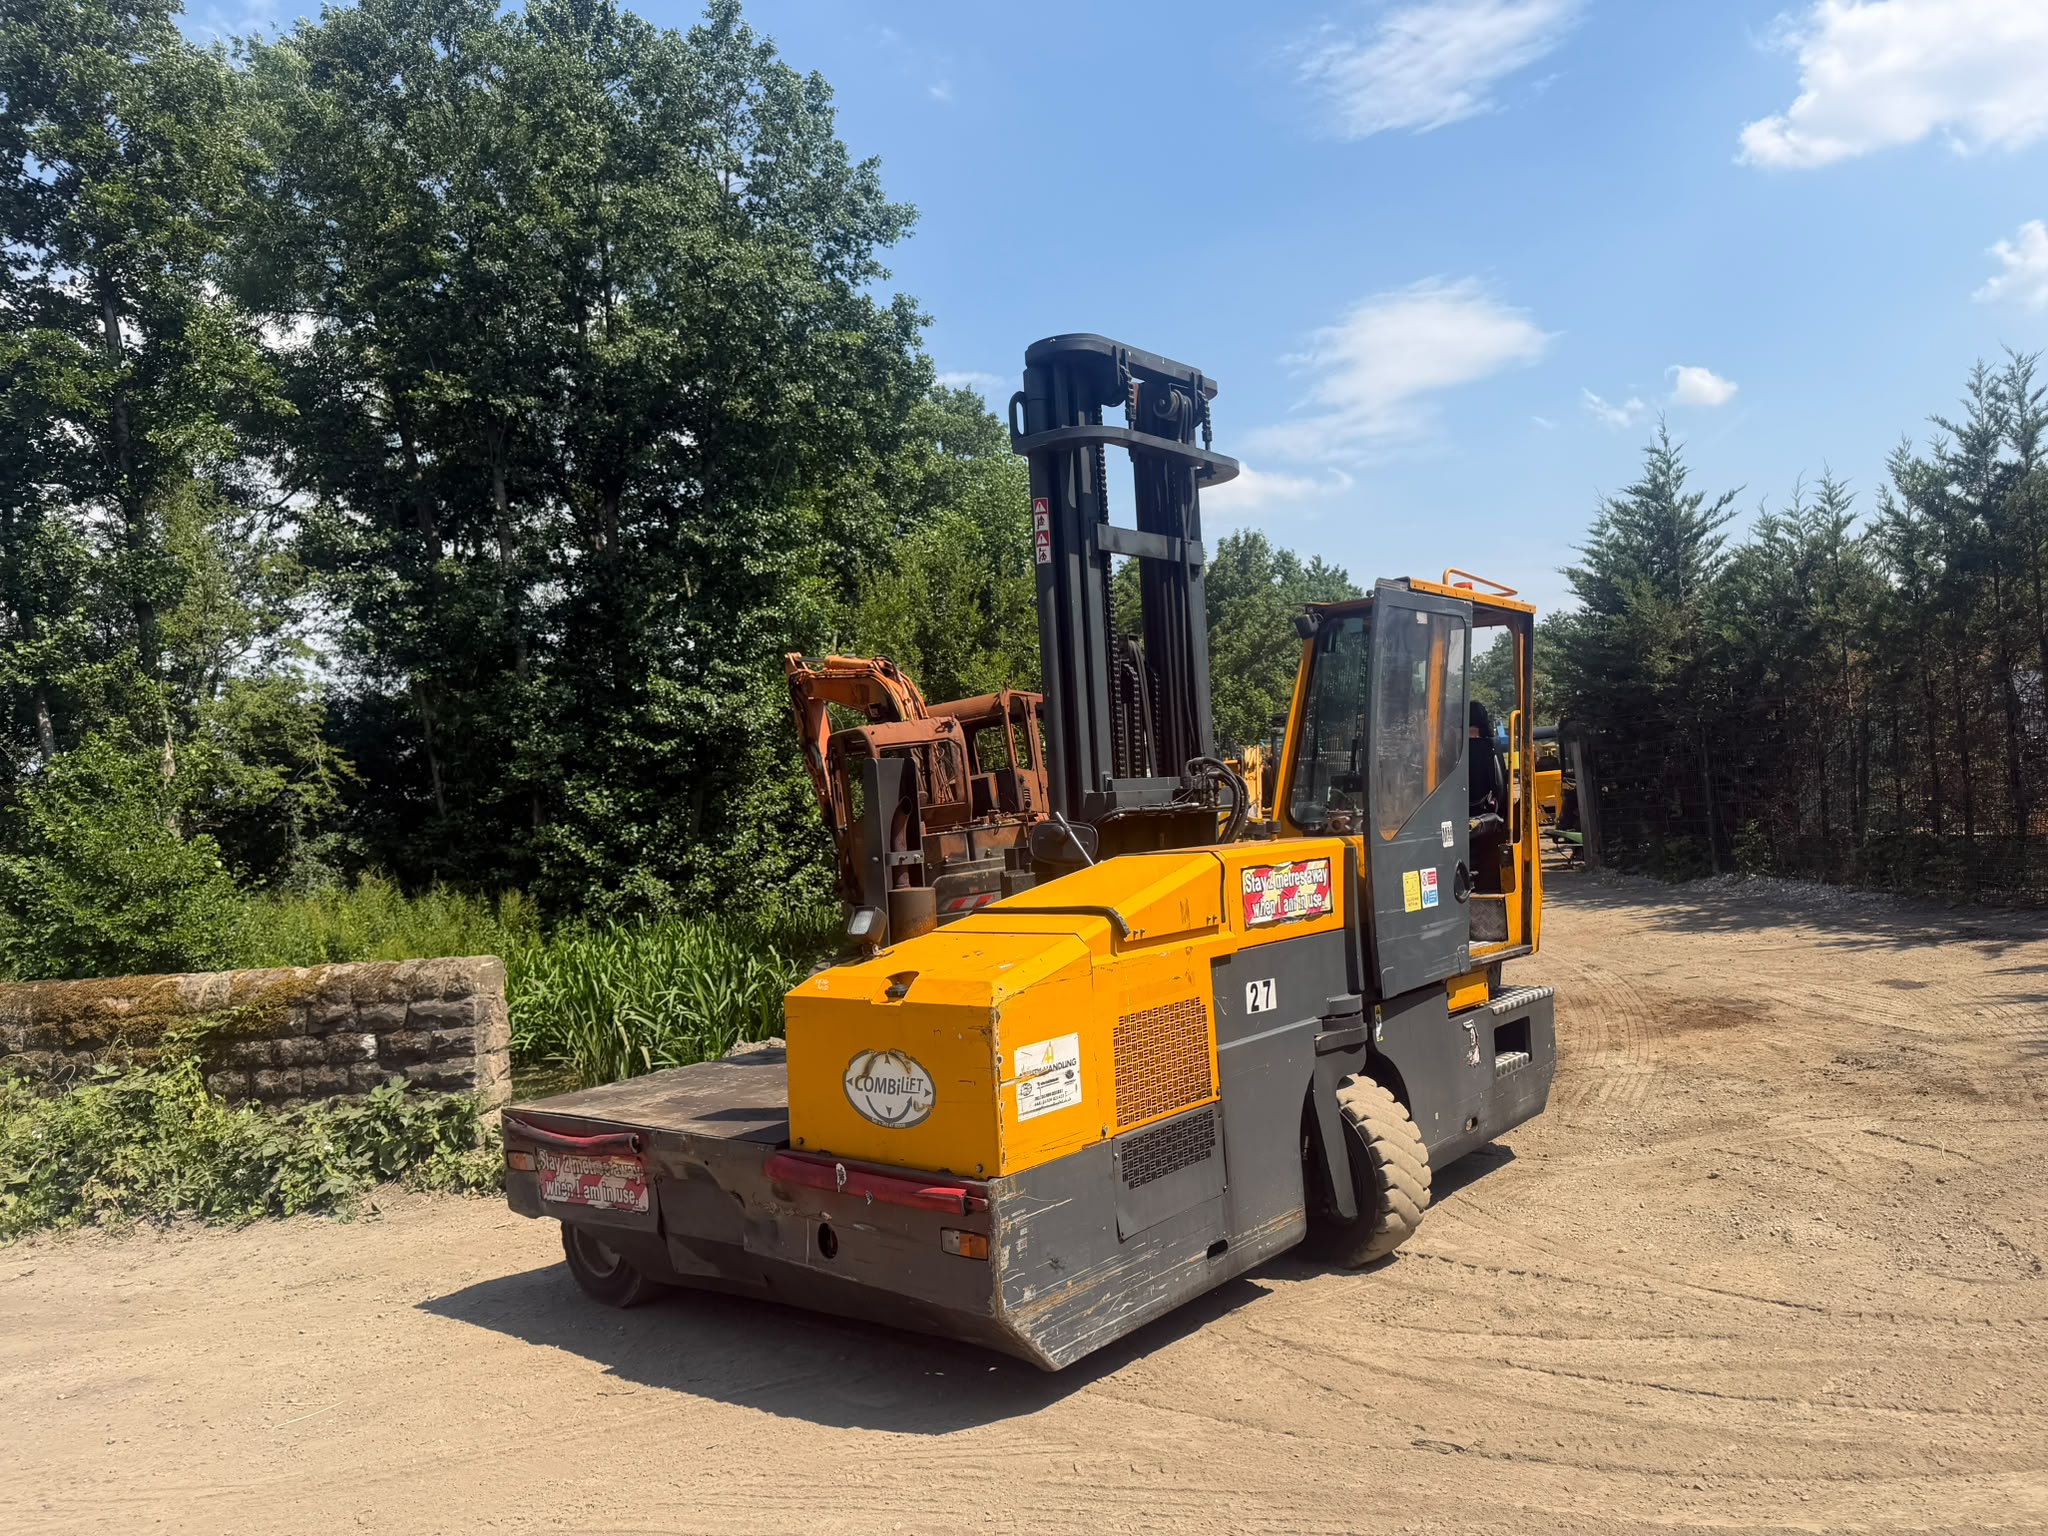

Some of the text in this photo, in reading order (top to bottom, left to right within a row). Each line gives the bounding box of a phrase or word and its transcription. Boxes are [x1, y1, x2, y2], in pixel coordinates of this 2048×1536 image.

[1245, 872, 1267, 894] Stay
[1275, 870, 1305, 889] metres
[1306, 867, 1327, 886] away
[1252, 899, 1276, 918] when
[1283, 897, 1297, 912] am
[1297, 891, 1307, 910] in
[1250, 980, 1271, 1012] 27
[539, 1150, 560, 1175] Stay
[562, 1155, 572, 1174] 2
[613, 1163, 641, 1184] away
[546, 1179, 574, 1198] when
[584, 1184, 600, 1200] am
[602, 1180, 614, 1202] in
[618, 1187, 639, 1205] use.
